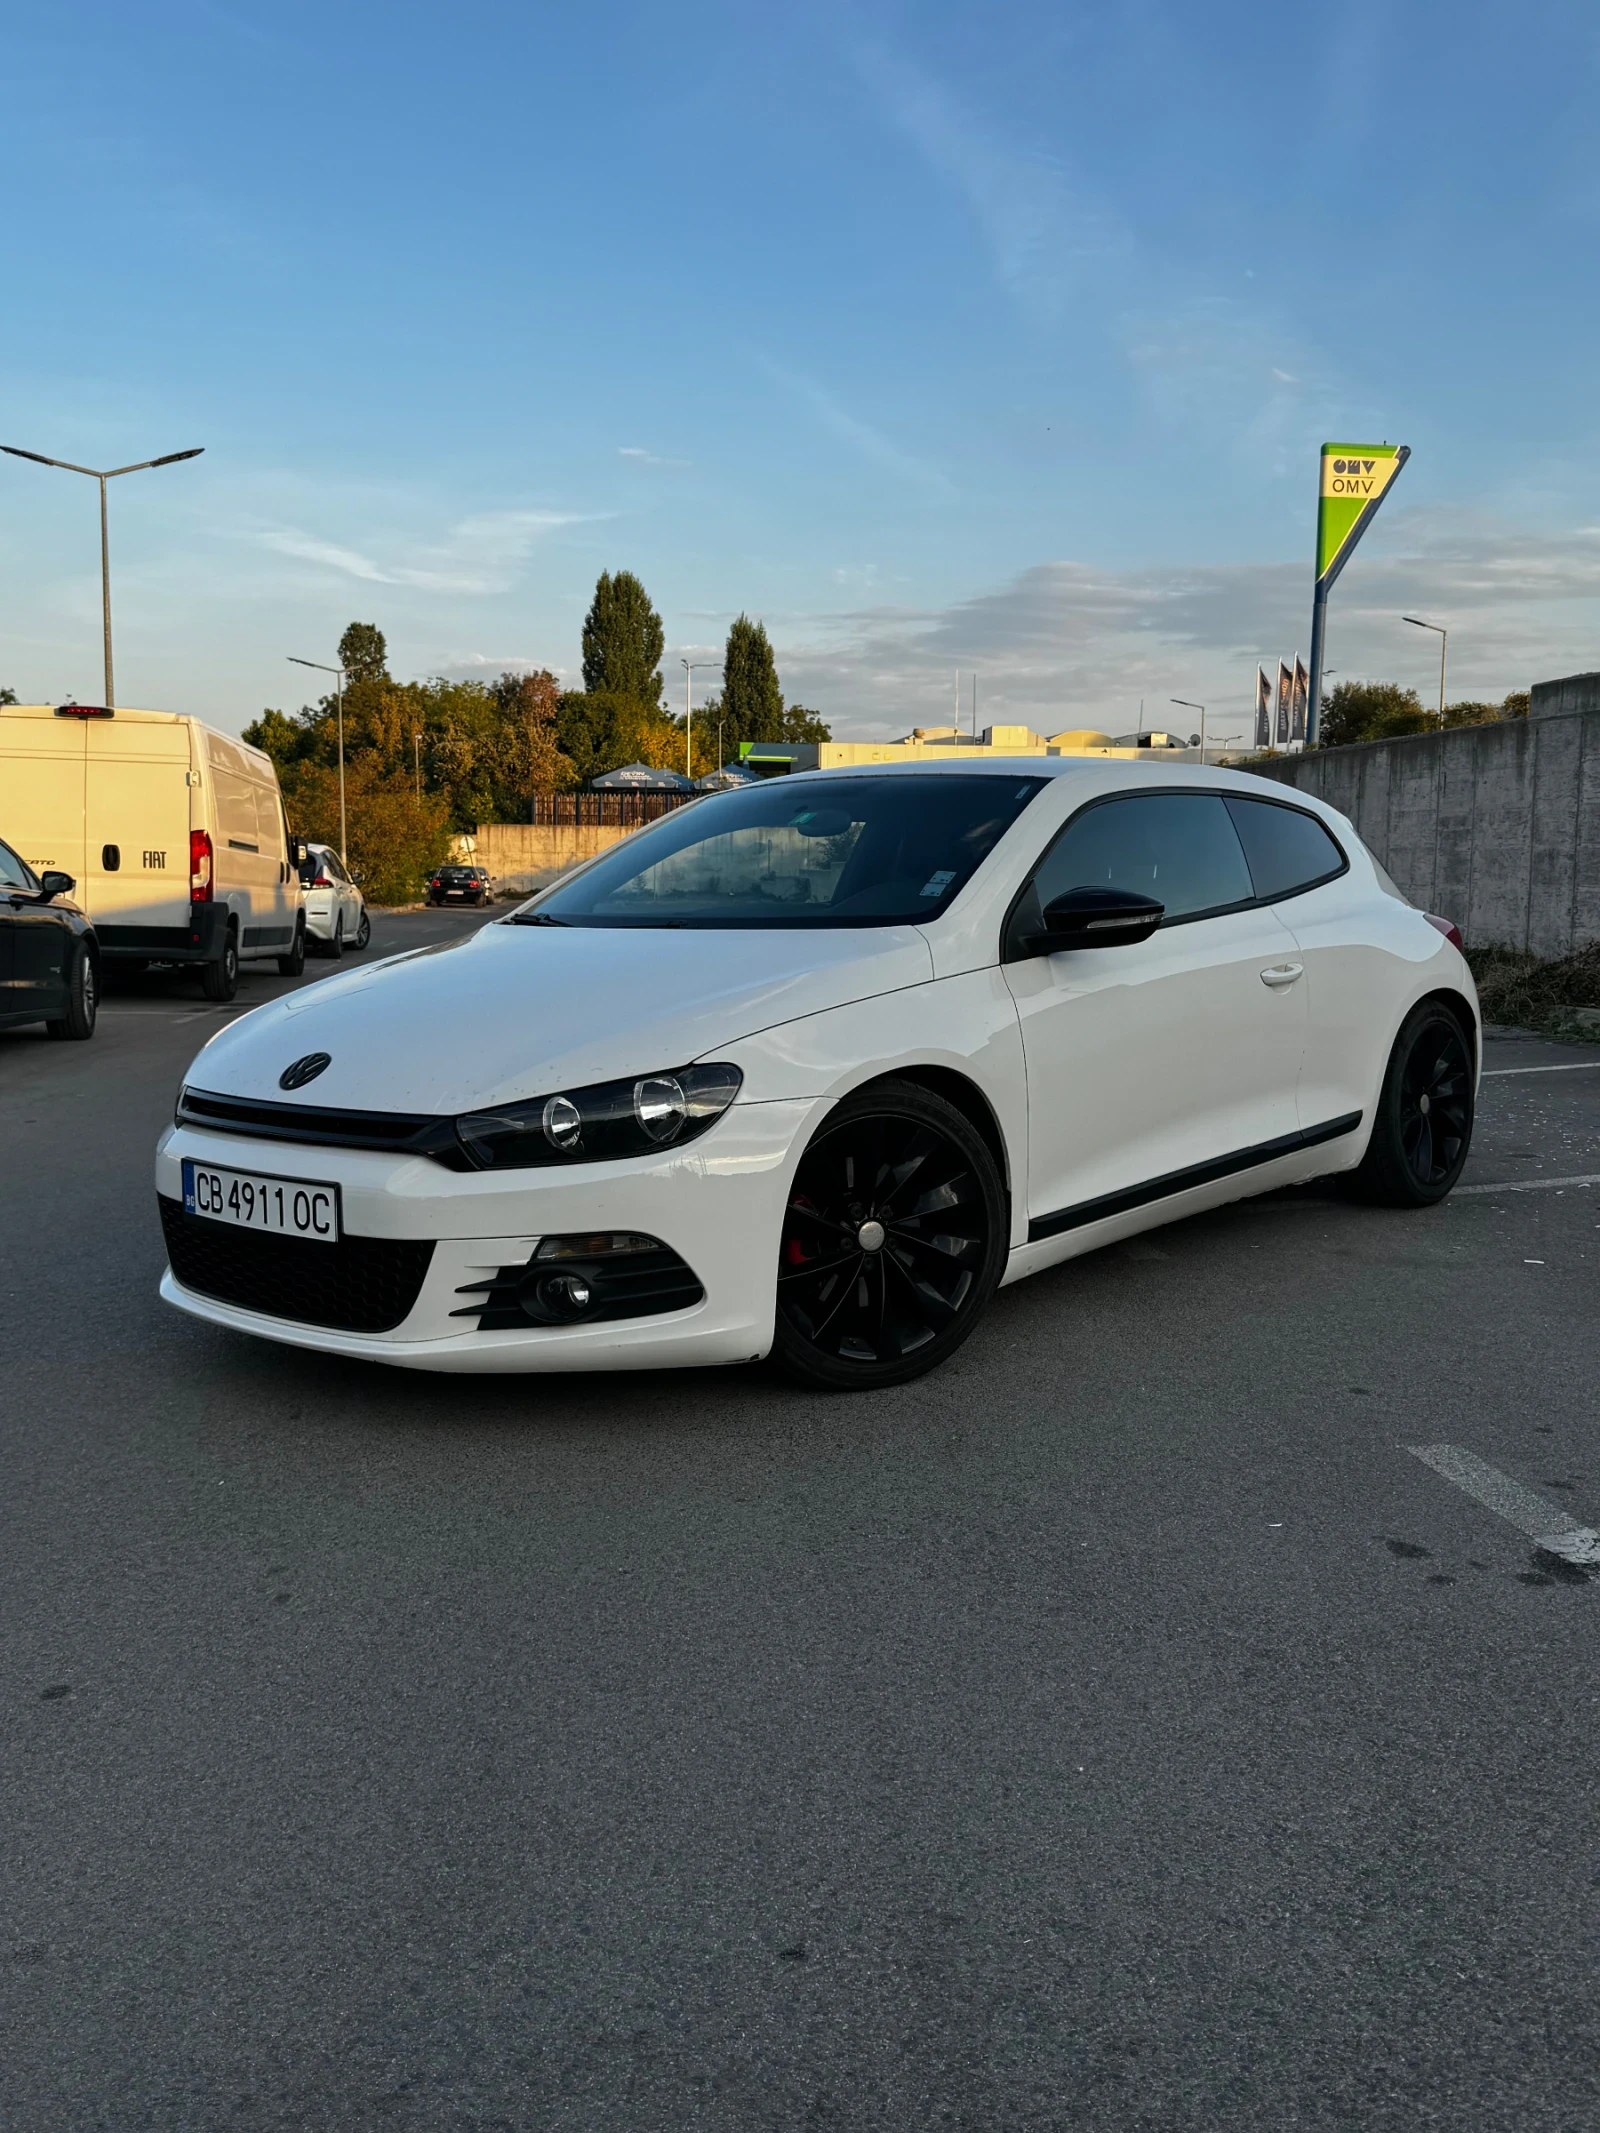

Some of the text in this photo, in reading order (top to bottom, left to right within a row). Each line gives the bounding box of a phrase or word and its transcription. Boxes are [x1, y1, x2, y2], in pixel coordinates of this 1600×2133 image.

[1332, 479, 1374, 494] OMV
[142, 851, 167, 869] FIAT
[186, 1194, 195, 1207] BG
